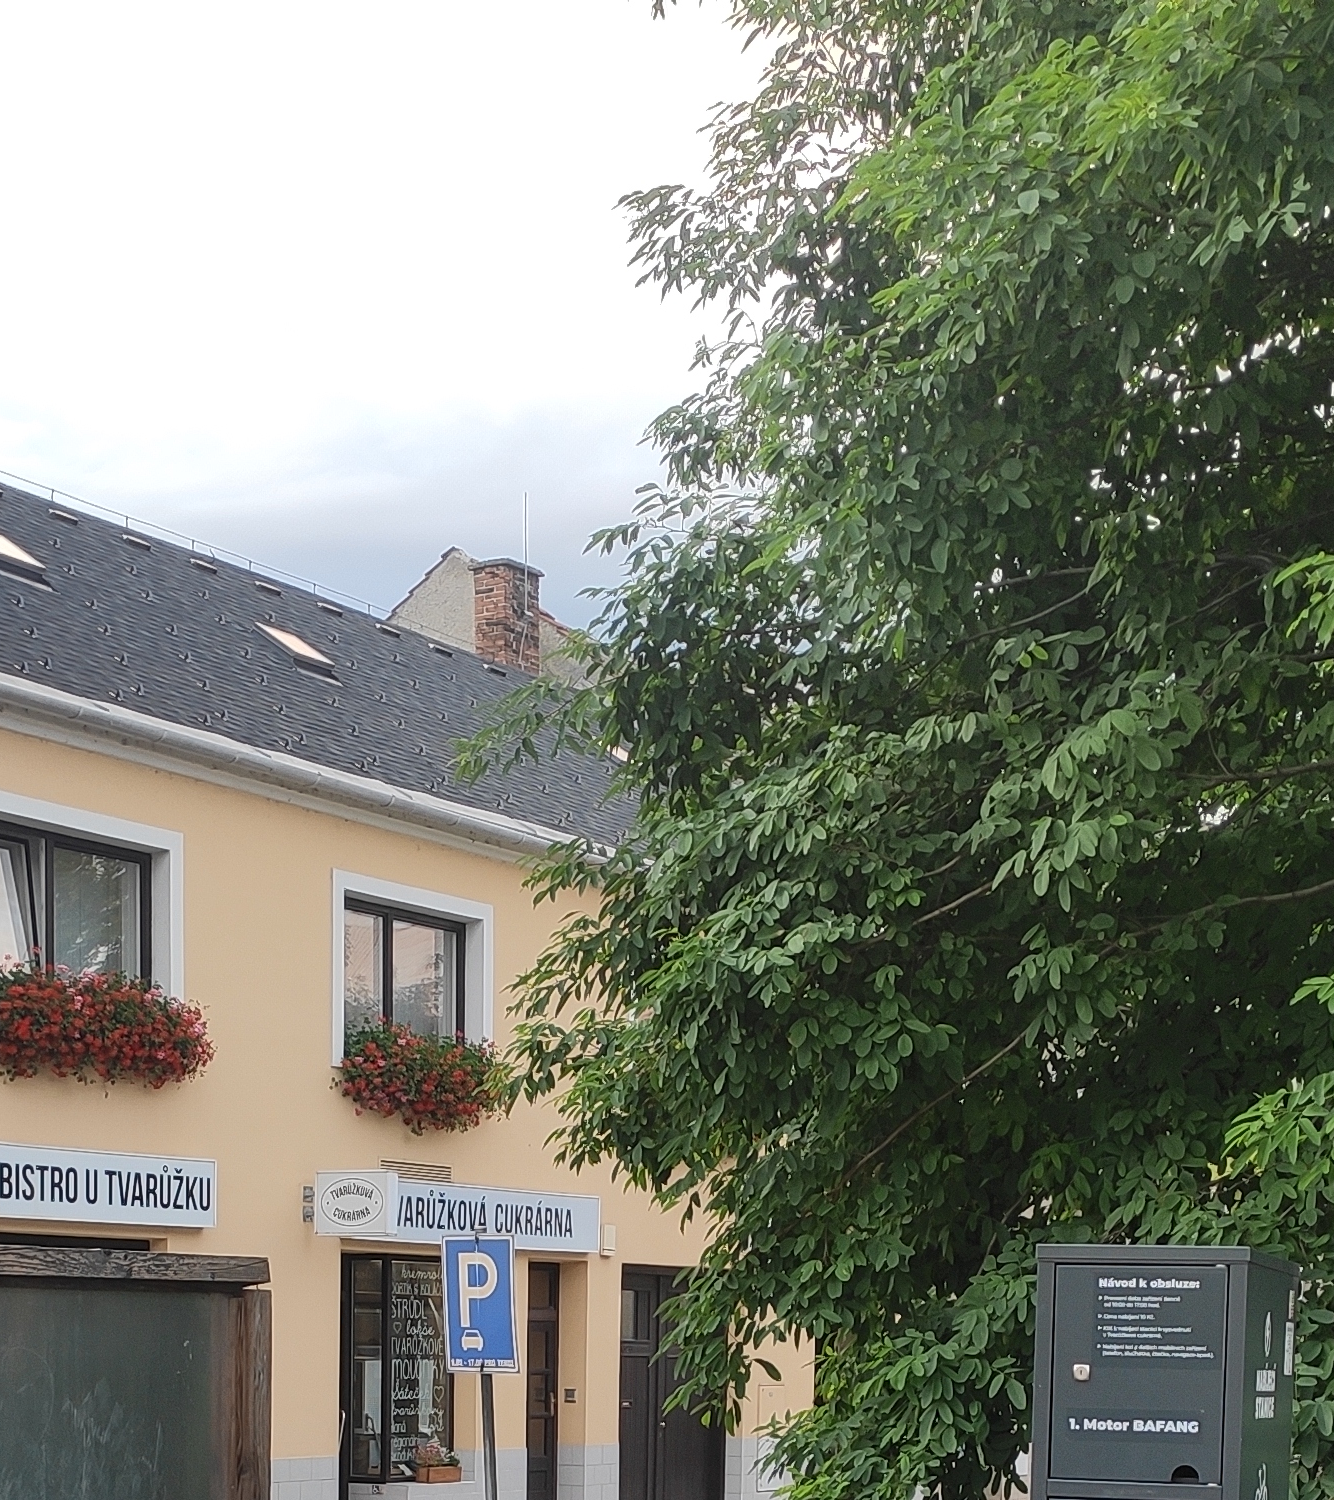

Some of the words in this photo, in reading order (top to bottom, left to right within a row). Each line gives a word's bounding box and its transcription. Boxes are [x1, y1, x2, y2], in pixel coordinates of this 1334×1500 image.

[0, 1162, 78, 1204] BISTRO
[85, 1168, 98, 1205] U
[104, 1164, 211, 1211] TVARŮŽKU
[494, 1201, 573, 1238] CUKRÁRNA
[457, 1252, 498, 1328] P
[1098, 1277, 1136, 1288] Návod
[1139, 1278, 1147, 1288] k
[1069, 1418, 1080, 1430] 1.
[1083, 1419, 1129, 1431] Motor
[1133, 1419, 1199, 1433] BAFANG
